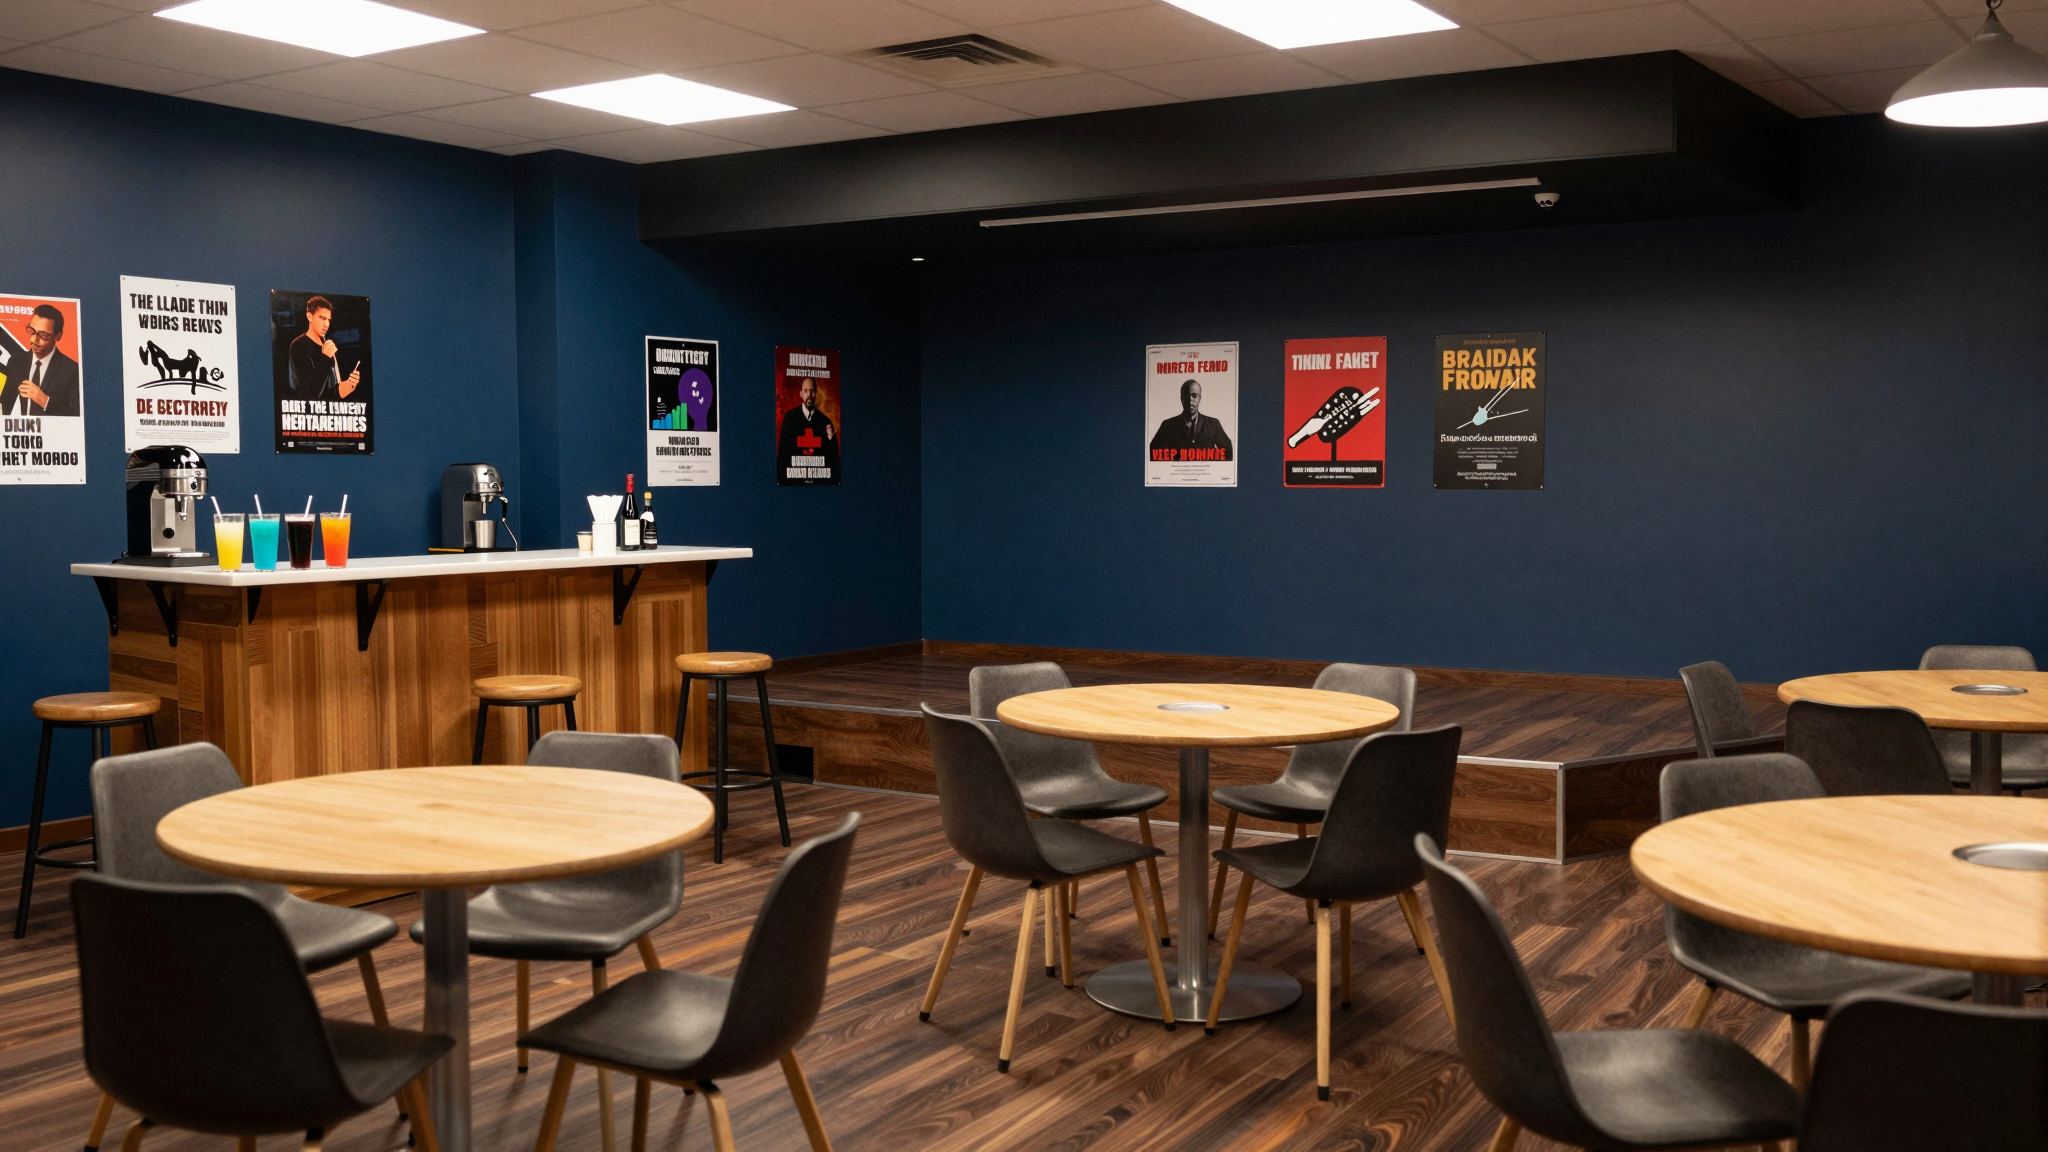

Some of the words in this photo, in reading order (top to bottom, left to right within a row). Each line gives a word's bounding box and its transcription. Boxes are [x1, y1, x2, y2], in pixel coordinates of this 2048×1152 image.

[130, 293, 153, 310] THE
[1442, 347, 1537, 368] BRAIDAK
[136, 398, 153, 414] DE
